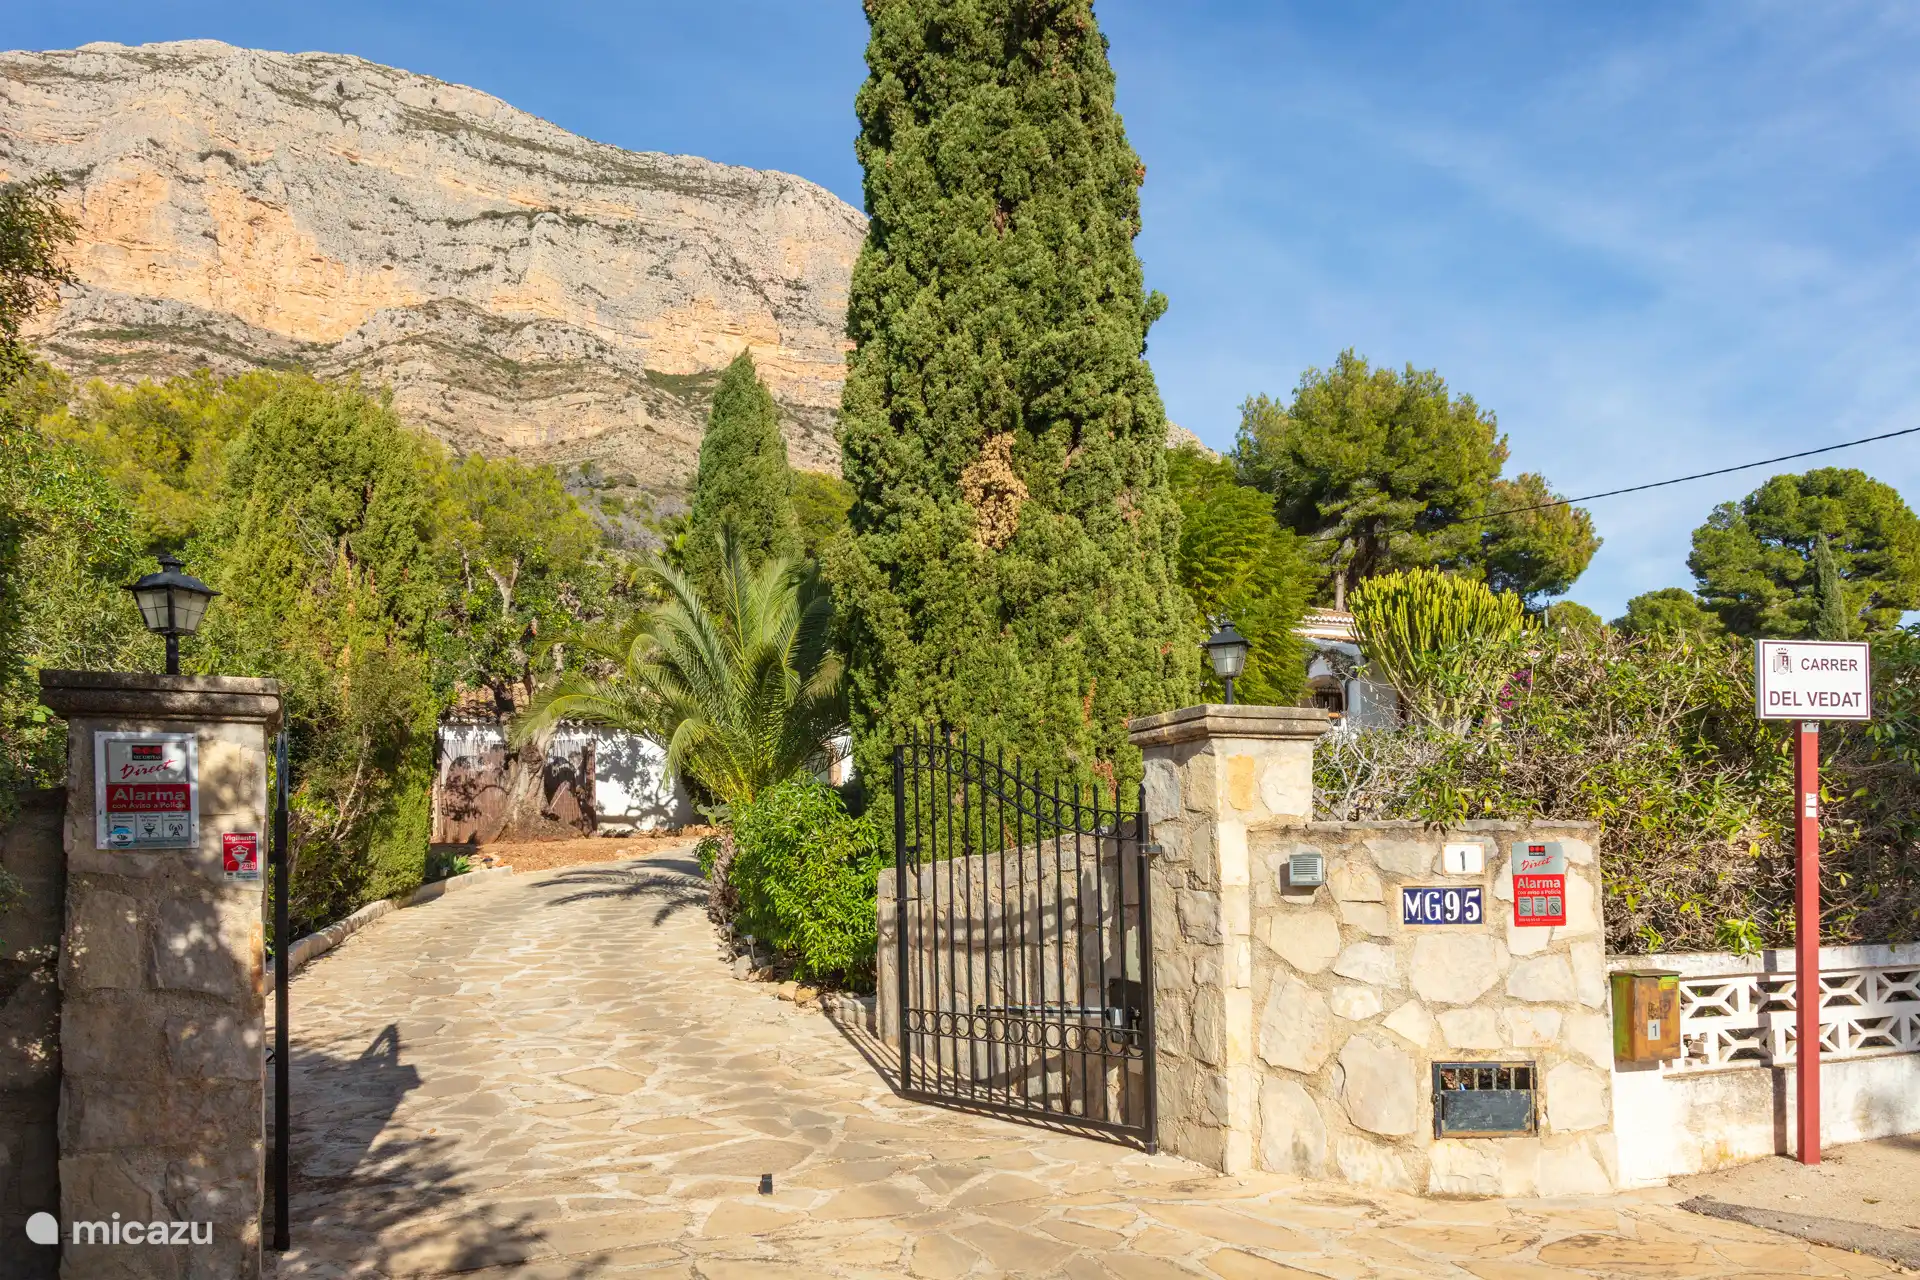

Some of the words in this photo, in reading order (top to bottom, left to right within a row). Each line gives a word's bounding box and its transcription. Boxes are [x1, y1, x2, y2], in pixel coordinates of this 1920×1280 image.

[1801, 658, 1858, 672] CARRER
[1769, 690, 1802, 706] DEL
[1806, 691, 1862, 707] VEDAT
[120, 759, 177, 779] Direct
[113, 787, 186, 801] Alarma
[1460, 850, 1466, 871] 1
[1521, 856, 1555, 872] Direct
[1517, 877, 1561, 889] Alarma
[1403, 889, 1480, 921] MG95
[1652, 1023, 1657, 1037] 1
